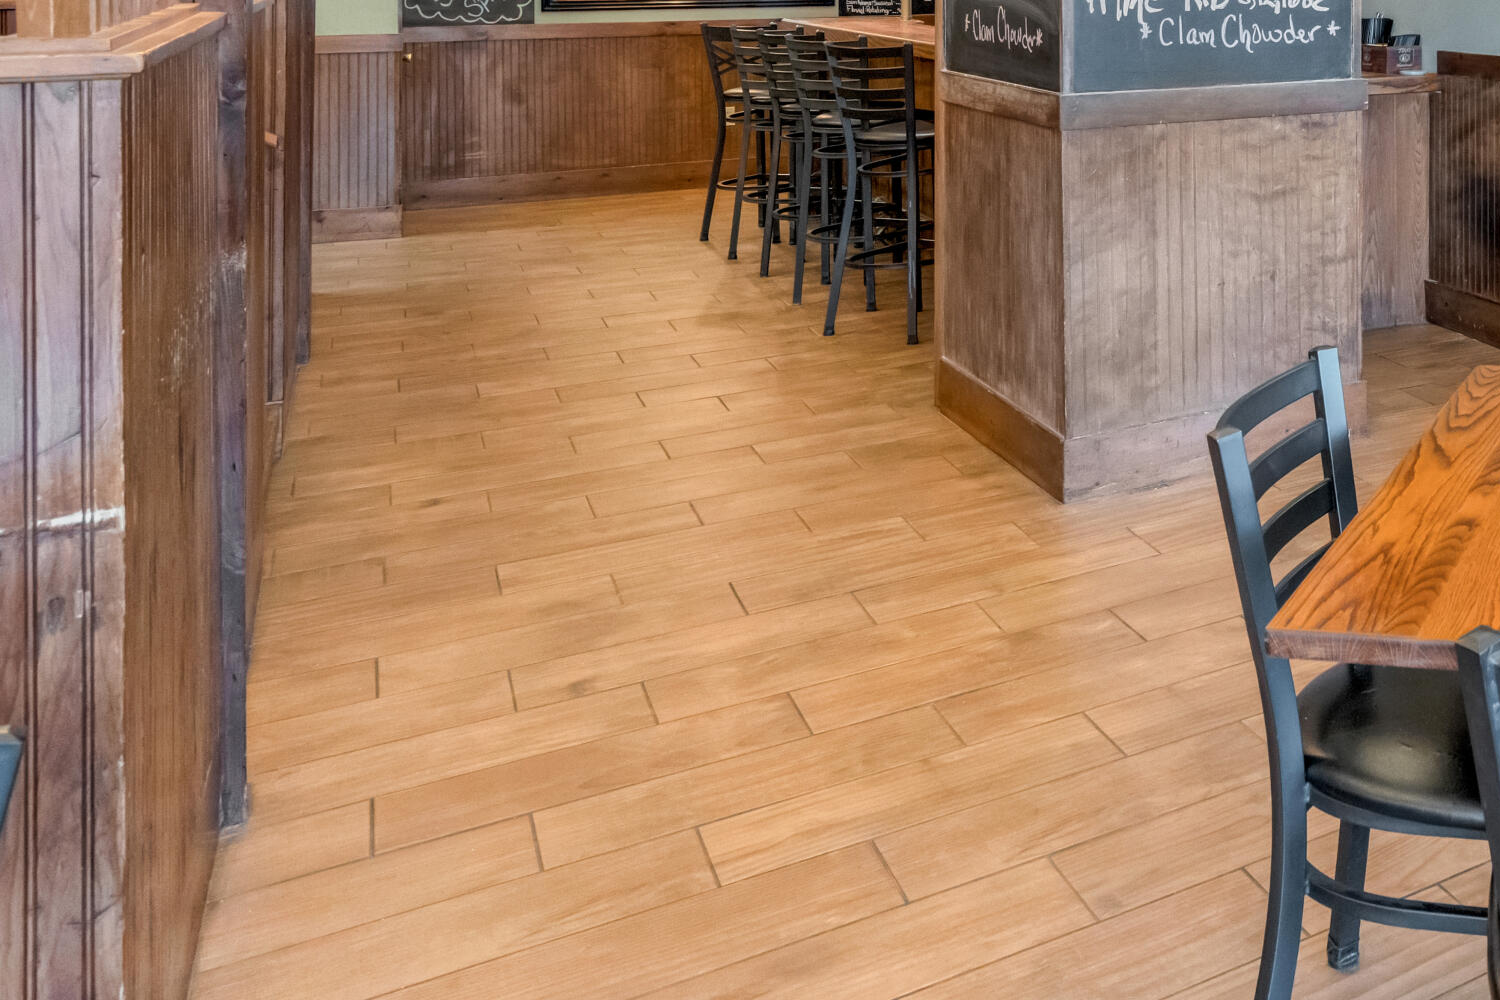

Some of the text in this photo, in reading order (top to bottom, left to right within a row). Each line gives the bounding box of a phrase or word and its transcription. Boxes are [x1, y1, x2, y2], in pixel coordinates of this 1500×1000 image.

[973, 9, 995, 43] Clam
[1159, 13, 1321, 53] Clam Chowder
